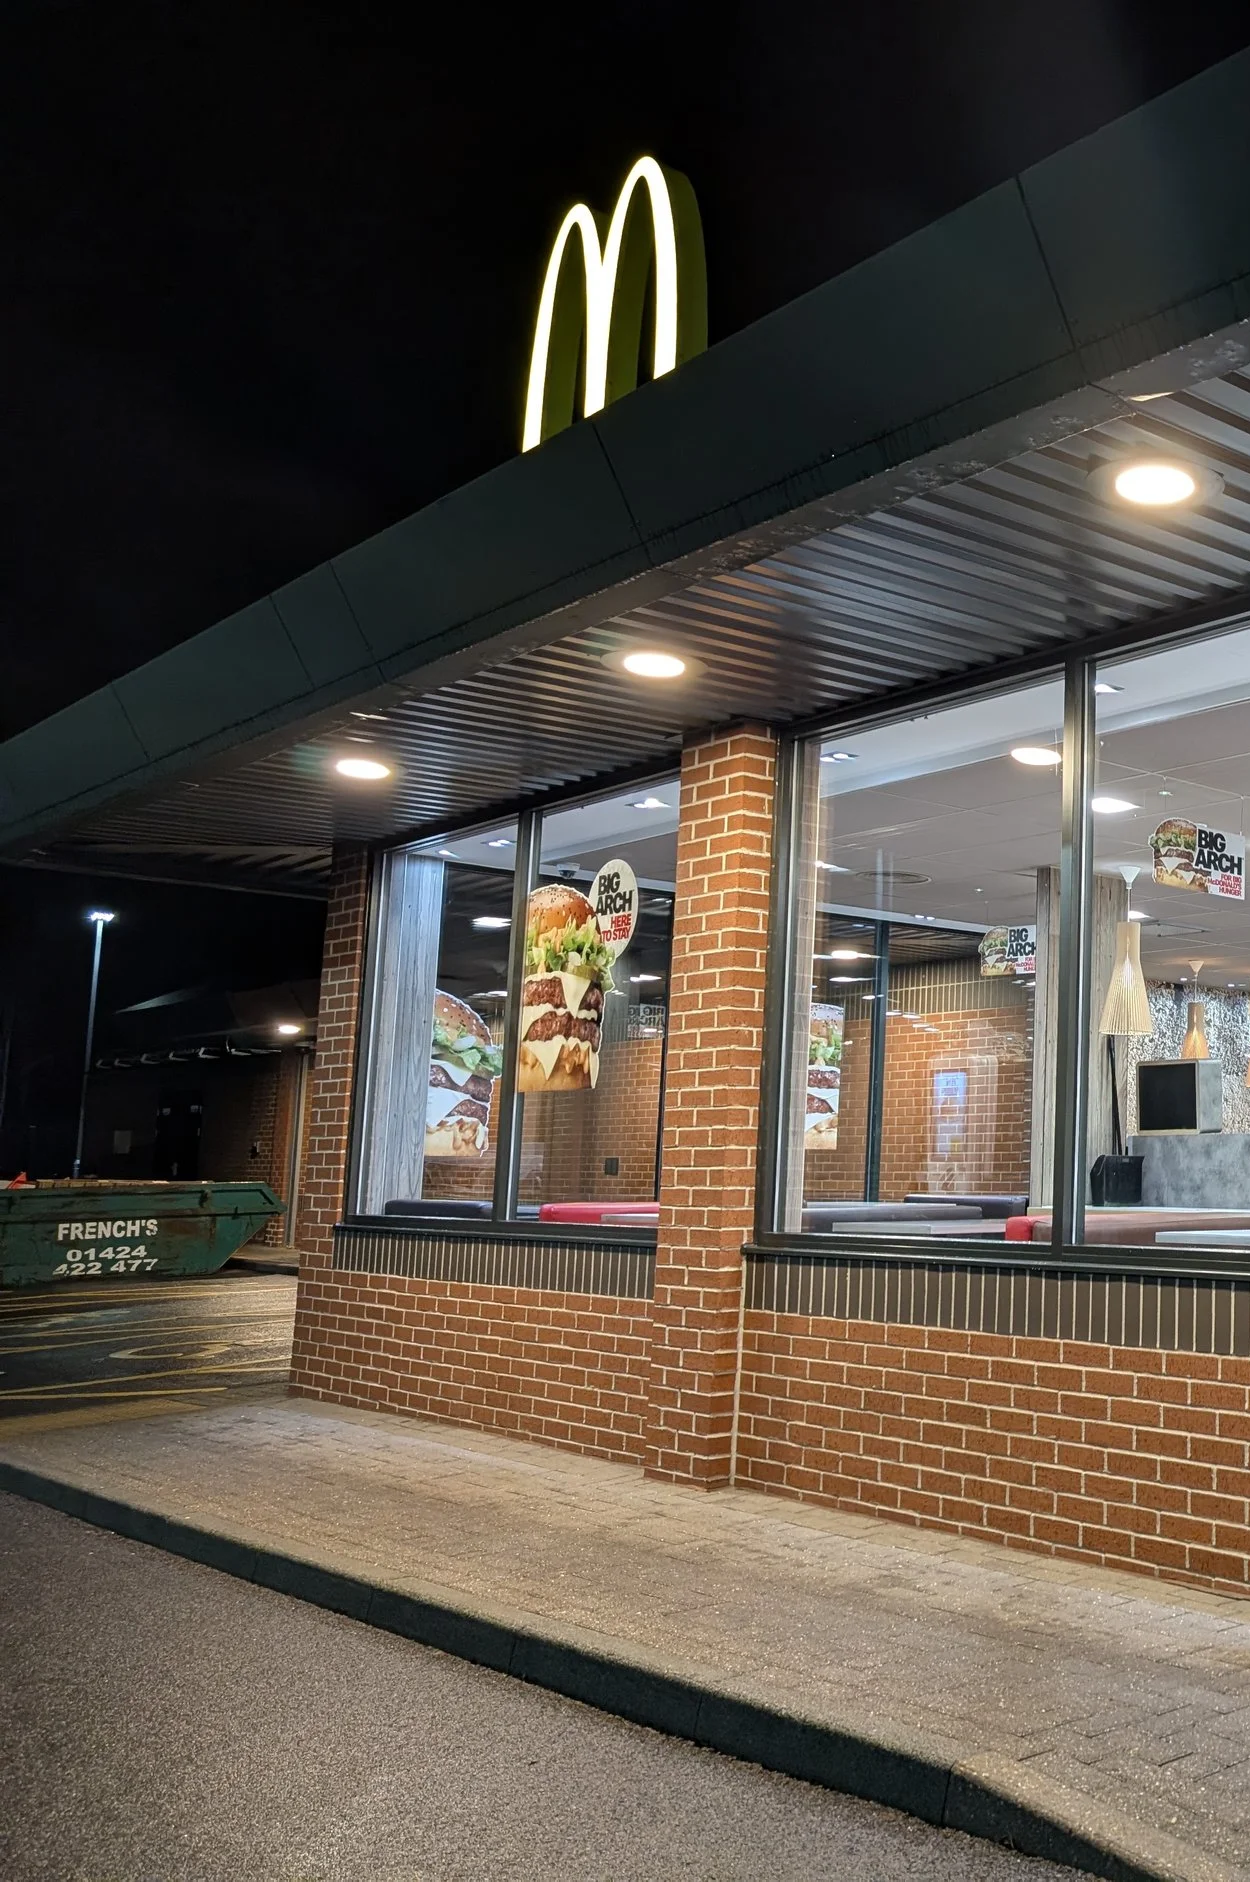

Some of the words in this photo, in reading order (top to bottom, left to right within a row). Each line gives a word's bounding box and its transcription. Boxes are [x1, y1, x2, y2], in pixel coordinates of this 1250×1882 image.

[1197, 829, 1226, 852] BIG
[1195, 849, 1242, 875] ARCH
[598, 872, 620, 896] BIG
[1221, 873, 1232, 881] FOR
[1219, 887, 1242, 896] HUNGER
[596, 890, 633, 916] ARCH
[611, 914, 632, 928] HERE
[602, 929, 612, 942] TO
[613, 926, 631, 940] STAY
[1009, 928, 1028, 943] BIG
[58, 1219, 158, 1241] FRENCH'S
[66, 1245, 147, 1262] 01424
[52, 1262, 102, 1277] 422
[110, 1258, 158, 1273] 477
